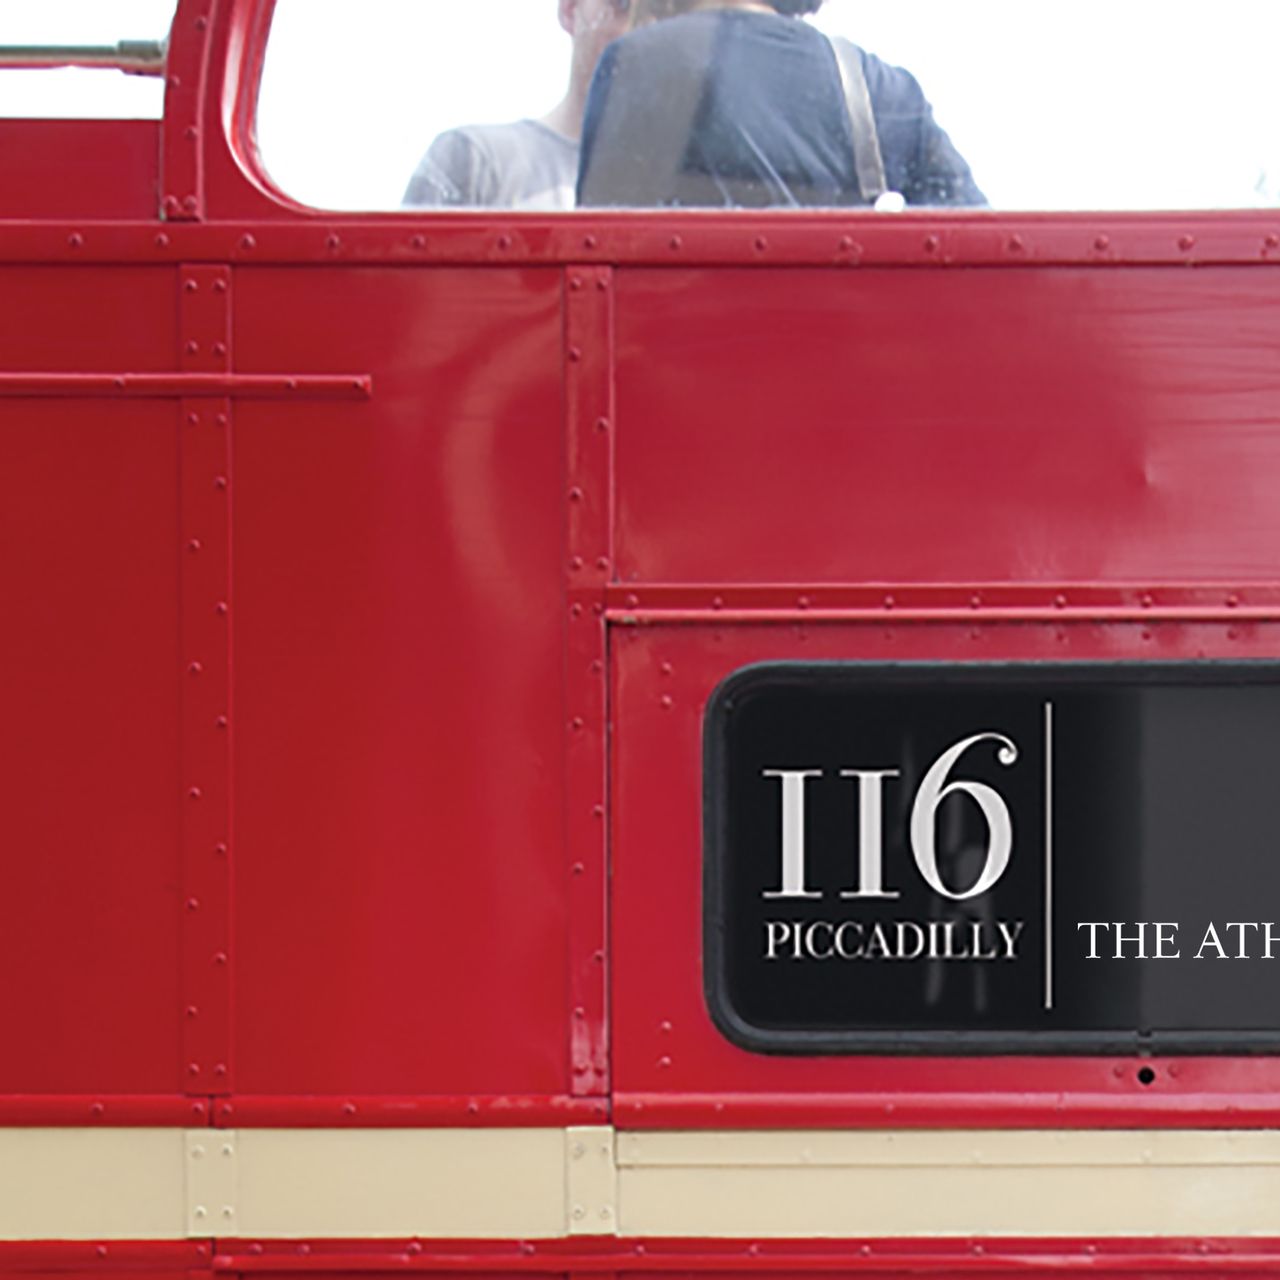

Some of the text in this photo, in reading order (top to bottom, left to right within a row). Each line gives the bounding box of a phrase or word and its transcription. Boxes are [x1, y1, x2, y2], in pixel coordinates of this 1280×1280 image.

[762, 732, 1019, 901] 116
[764, 922, 1024, 961] PICCADILLY
[1077, 922, 1182, 960] THE
